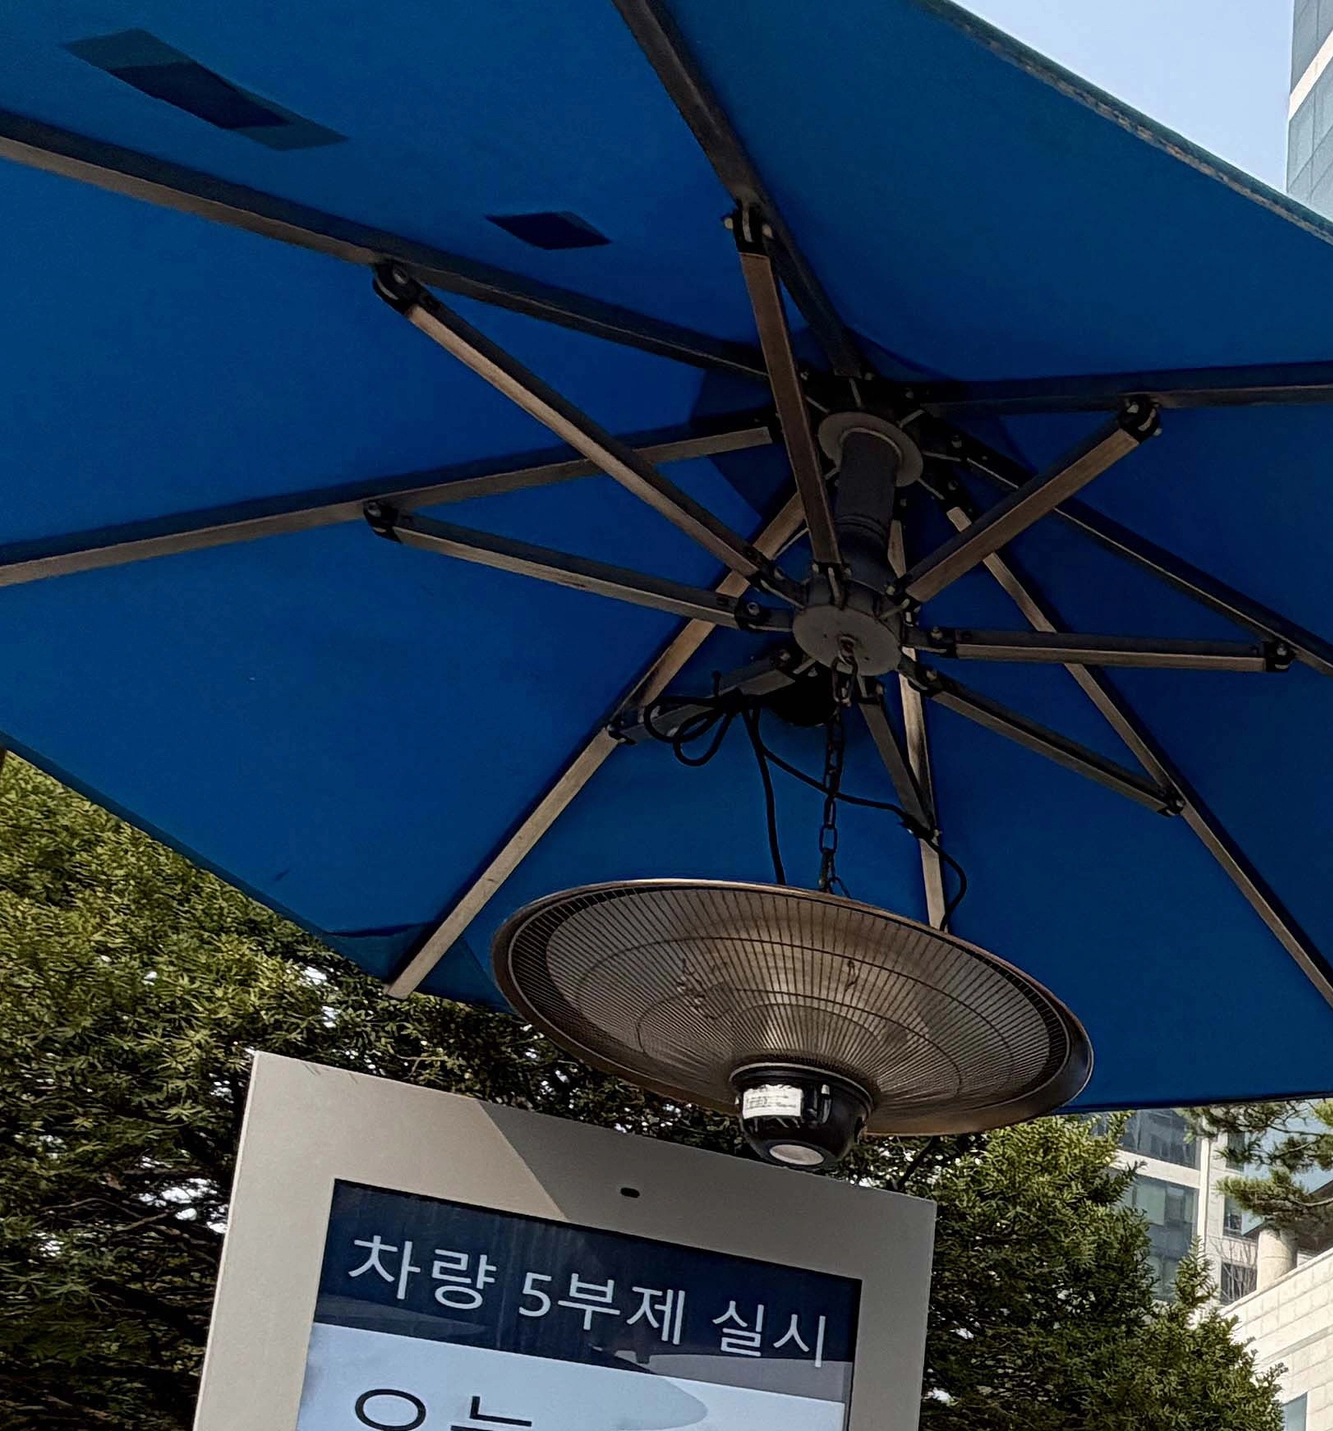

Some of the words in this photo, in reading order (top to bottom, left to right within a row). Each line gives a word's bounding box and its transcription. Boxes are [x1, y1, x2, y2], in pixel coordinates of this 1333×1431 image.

[348, 1234, 496, 1310] 차량
[517, 1270, 686, 1345] 5부제
[712, 1300, 826, 1368] 실시
